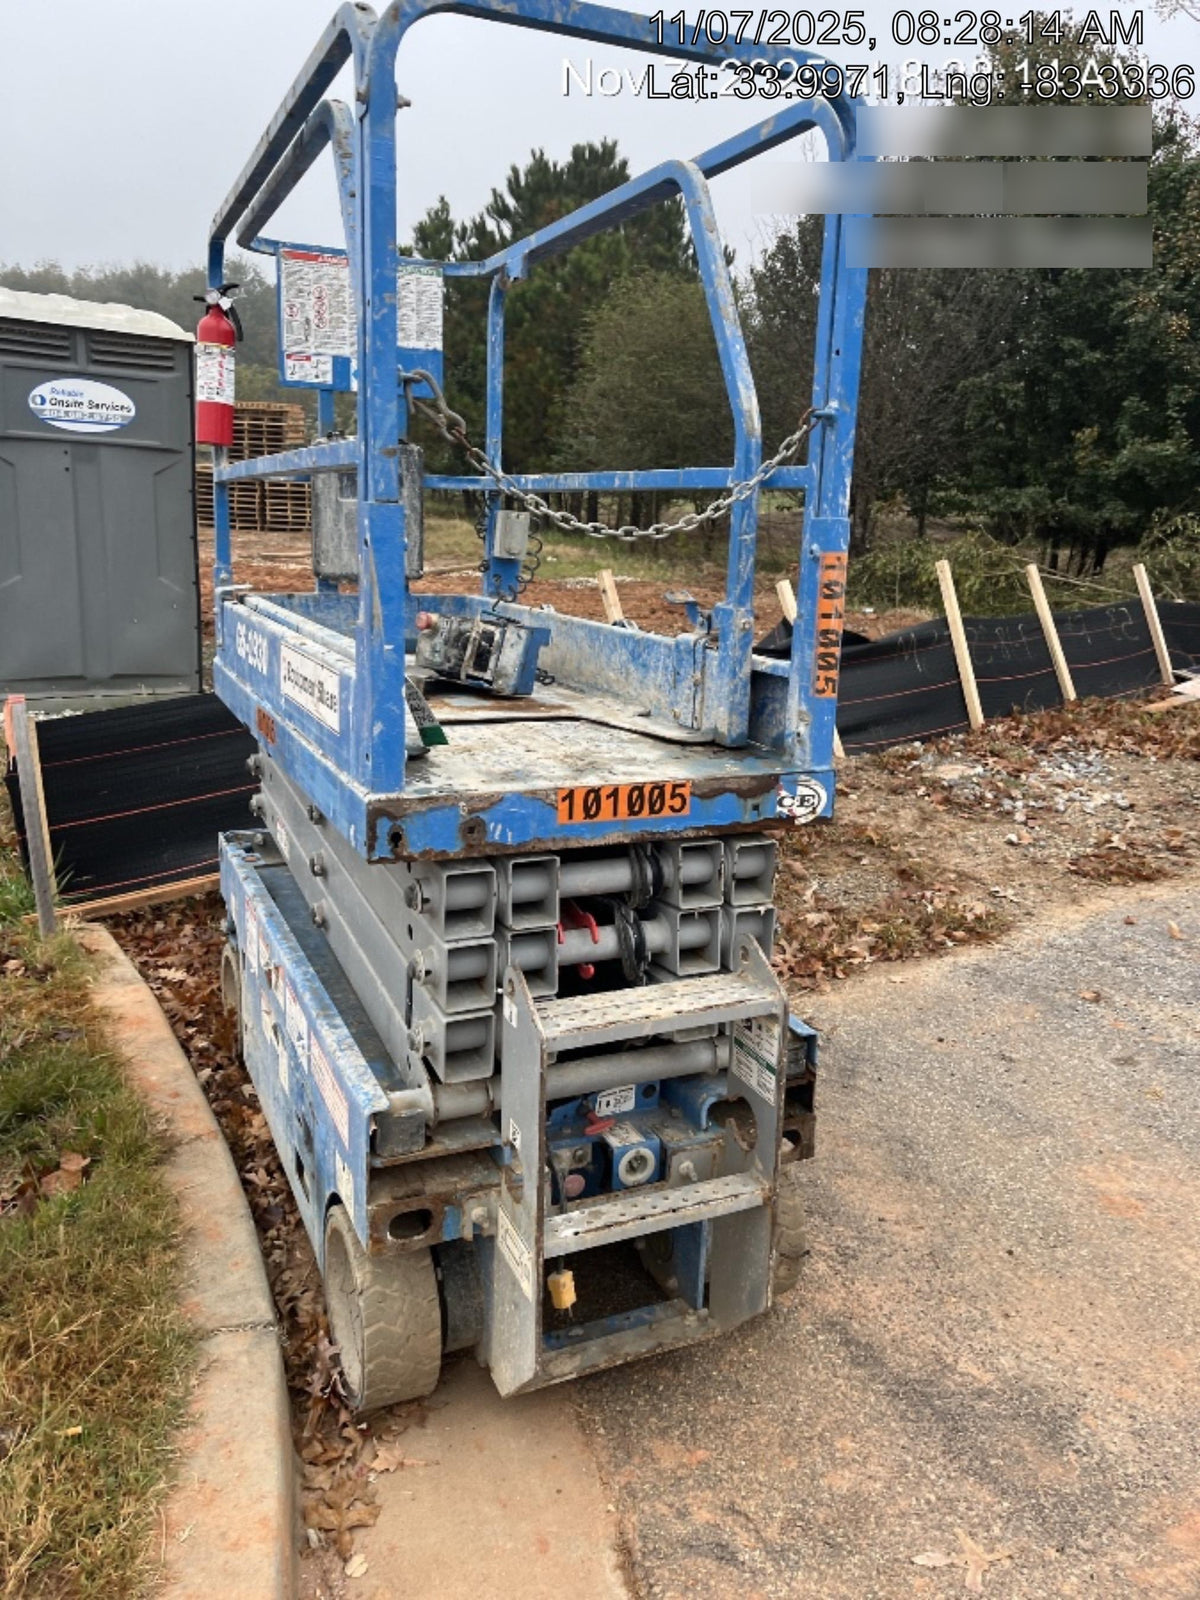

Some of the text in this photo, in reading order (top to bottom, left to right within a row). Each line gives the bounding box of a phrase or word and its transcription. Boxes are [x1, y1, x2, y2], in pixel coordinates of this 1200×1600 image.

[49, 397, 132, 414] Onsite Services
[561, 782, 688, 821] 101005
